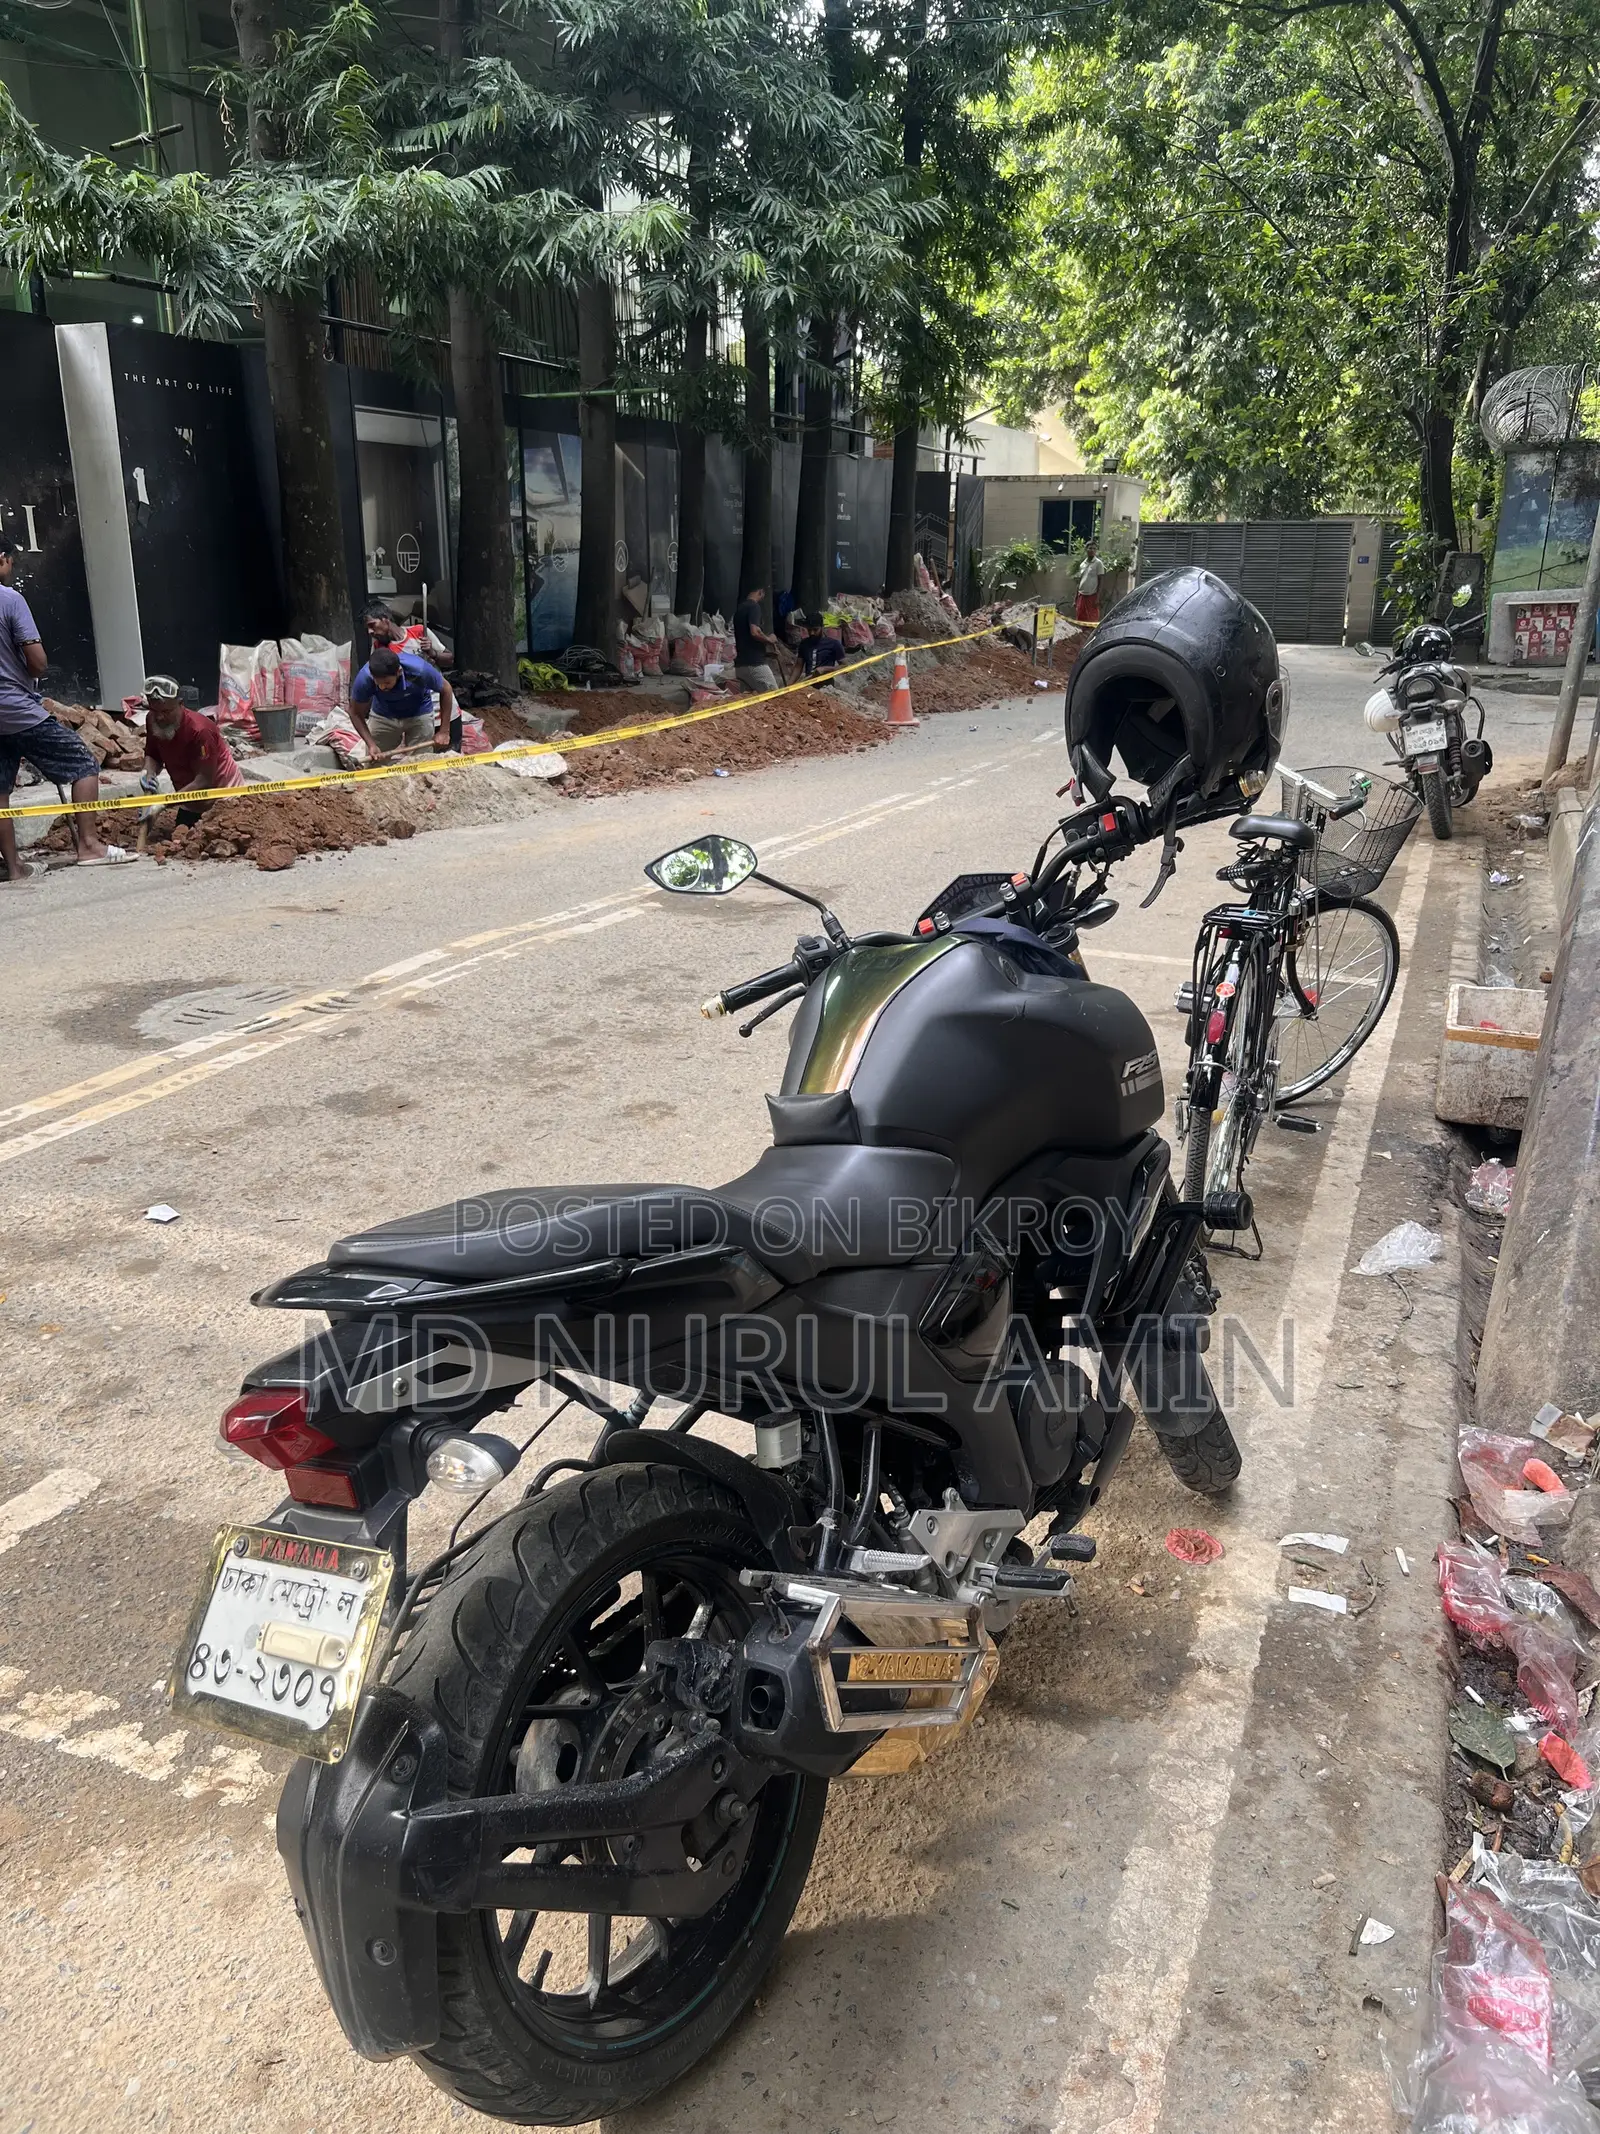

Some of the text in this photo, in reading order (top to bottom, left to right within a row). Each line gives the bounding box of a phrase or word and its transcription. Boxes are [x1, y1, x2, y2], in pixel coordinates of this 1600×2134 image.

[124, 372, 233, 396] THE ART OF LIFE
[260, 1535, 339, 1570] YAMAHA
[221, 1567, 267, 1599] ঢাকা
